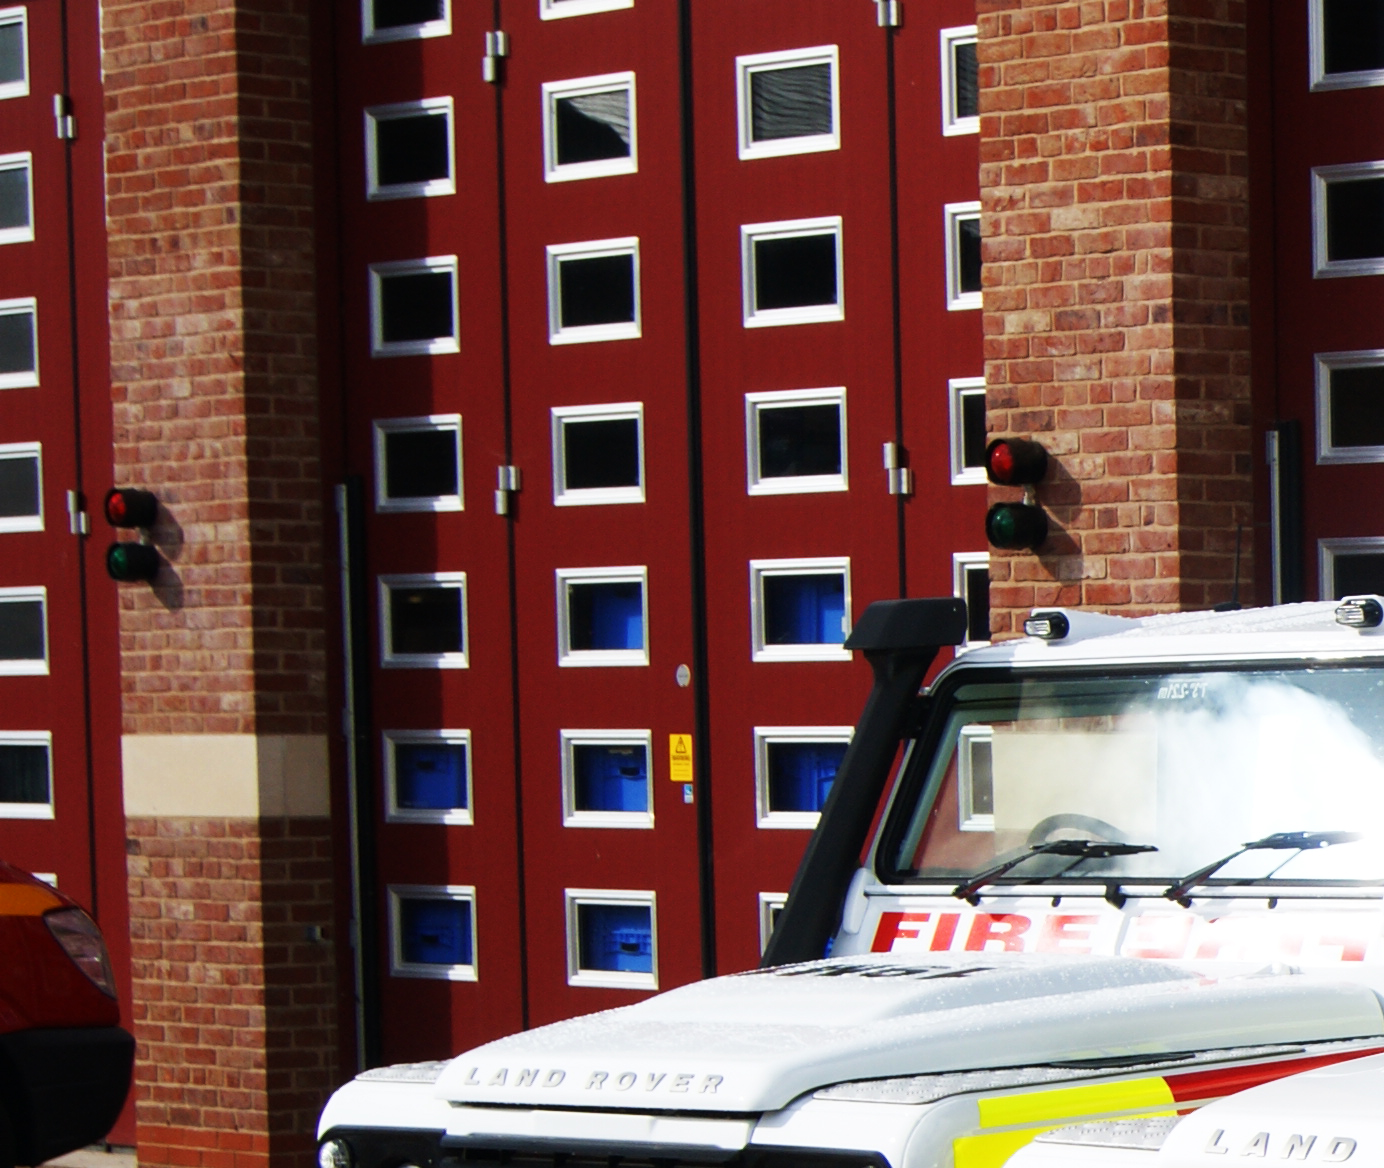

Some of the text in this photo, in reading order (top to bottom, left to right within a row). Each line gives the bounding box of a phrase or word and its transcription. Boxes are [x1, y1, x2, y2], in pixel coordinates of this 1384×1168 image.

[869, 911, 1100, 953] FIRE
[464, 1067, 725, 1094] LAND ROVER
[1203, 1129, 1358, 1163] LAND
